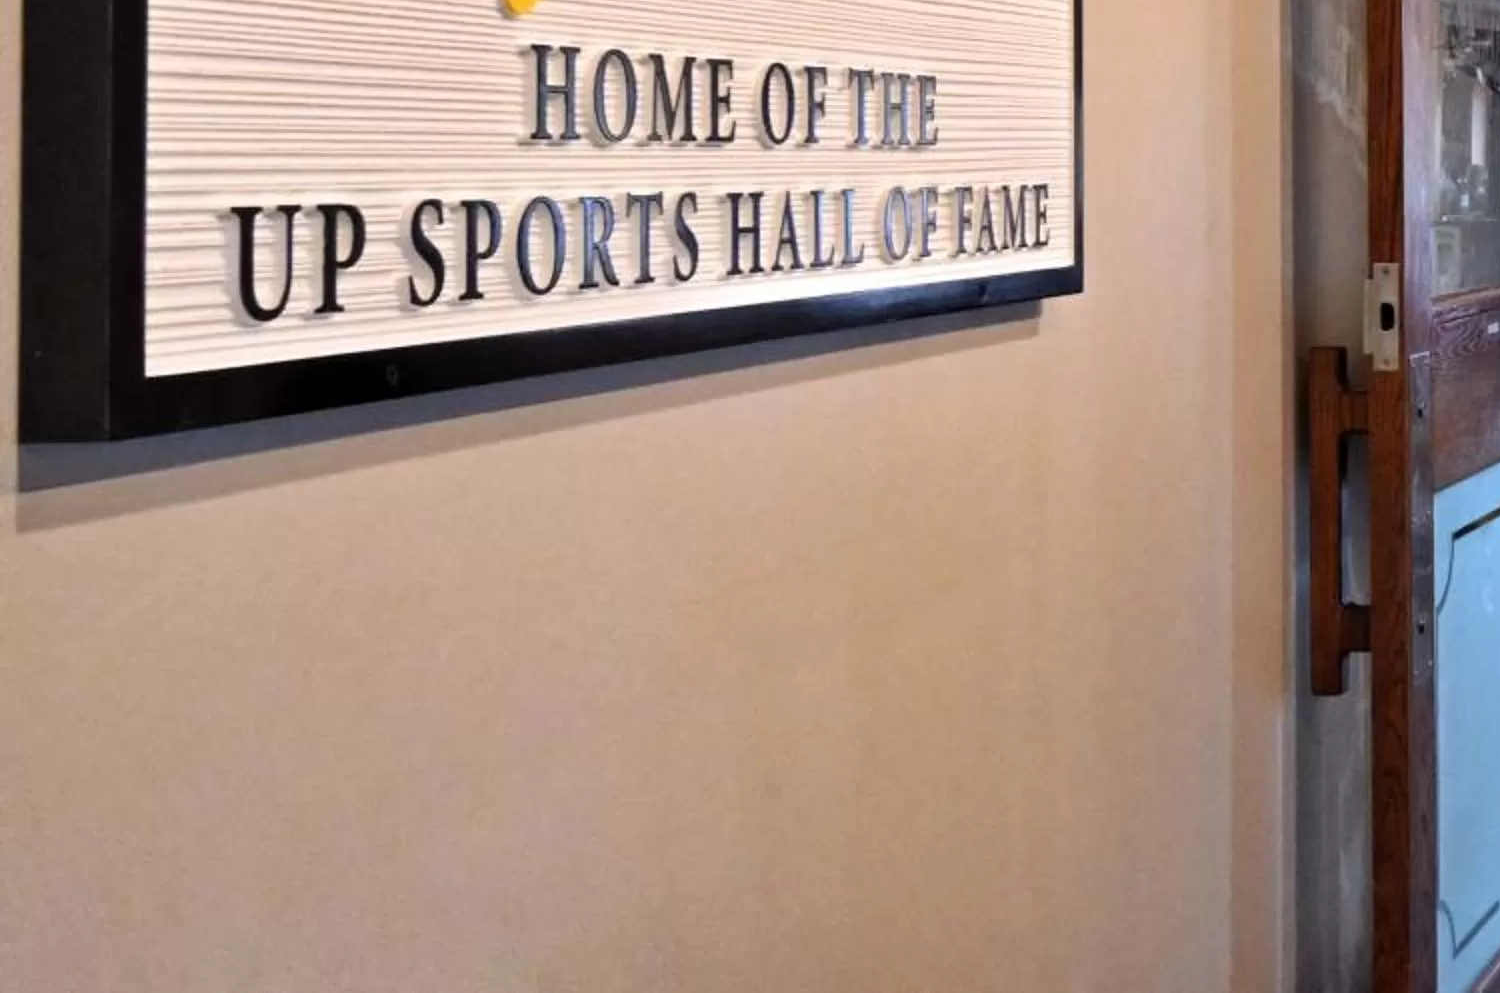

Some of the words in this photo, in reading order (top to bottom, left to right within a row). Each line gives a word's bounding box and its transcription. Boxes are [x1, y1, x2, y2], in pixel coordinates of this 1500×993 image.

[530, 44, 737, 143] HOME
[761, 62, 829, 145] OF
[848, 66, 938, 146] THE
[230, 203, 366, 322] UP
[408, 191, 698, 307] SPORTS
[727, 188, 864, 274] HALL
[883, 185, 939, 264] OF
[953, 183, 1050, 256] FAME
